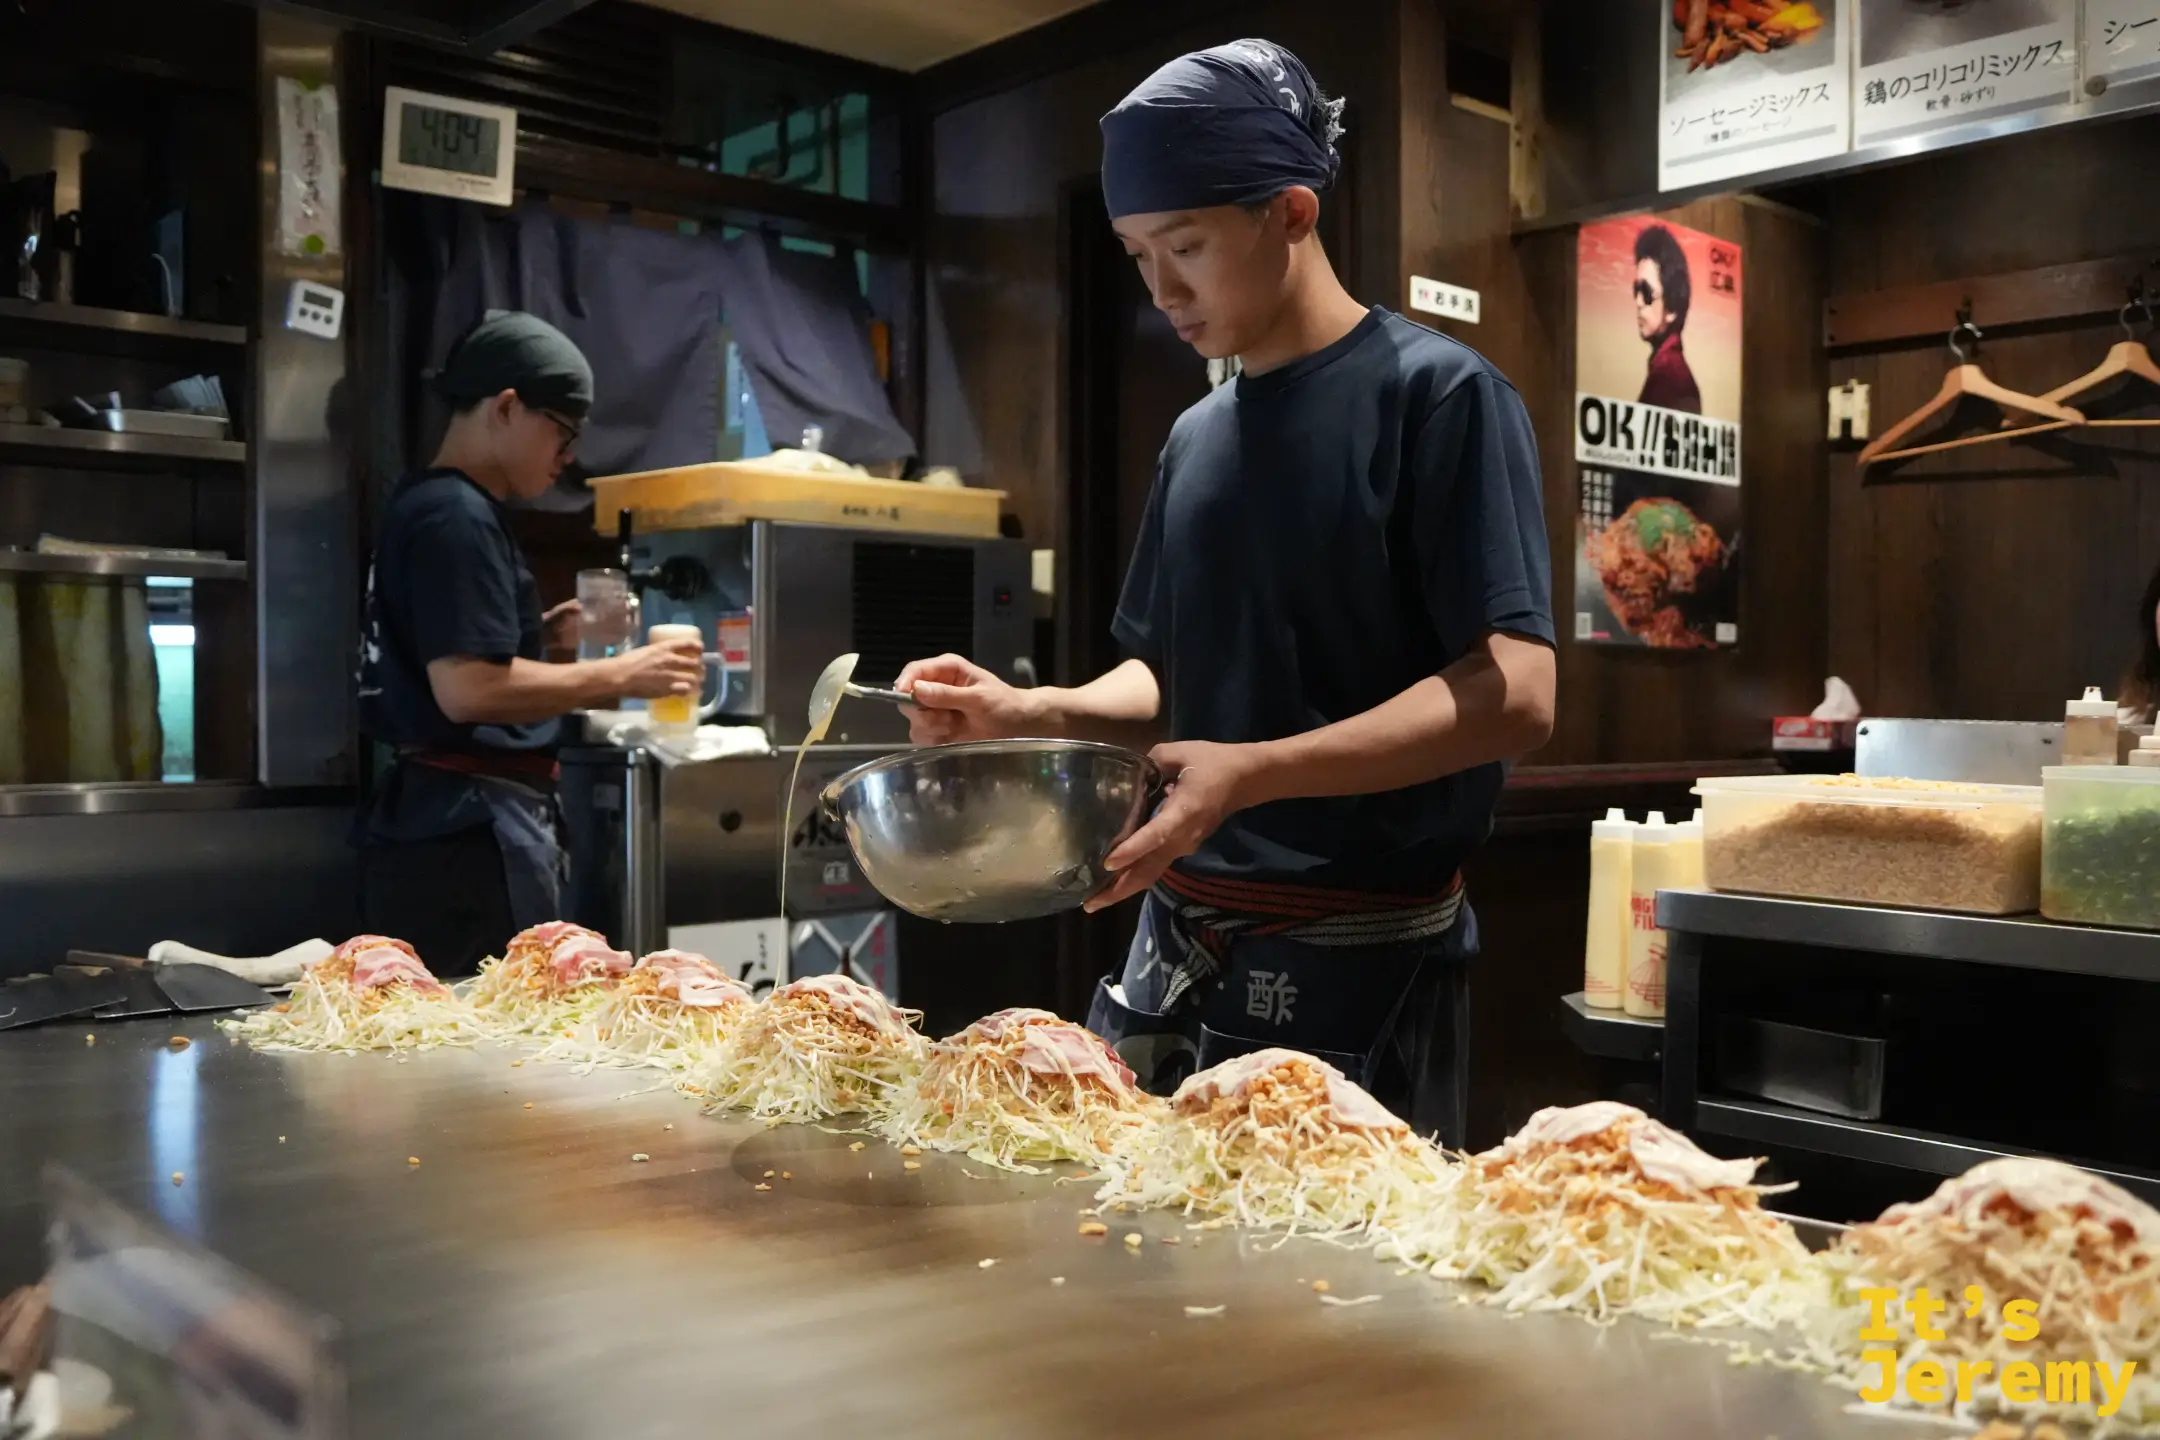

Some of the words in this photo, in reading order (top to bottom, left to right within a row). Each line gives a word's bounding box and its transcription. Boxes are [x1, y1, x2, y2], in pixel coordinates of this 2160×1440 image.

[1864, 38, 2065, 107] 鶏のコリコリミックス
[1670, 82, 1831, 137] ソーセージミックス
